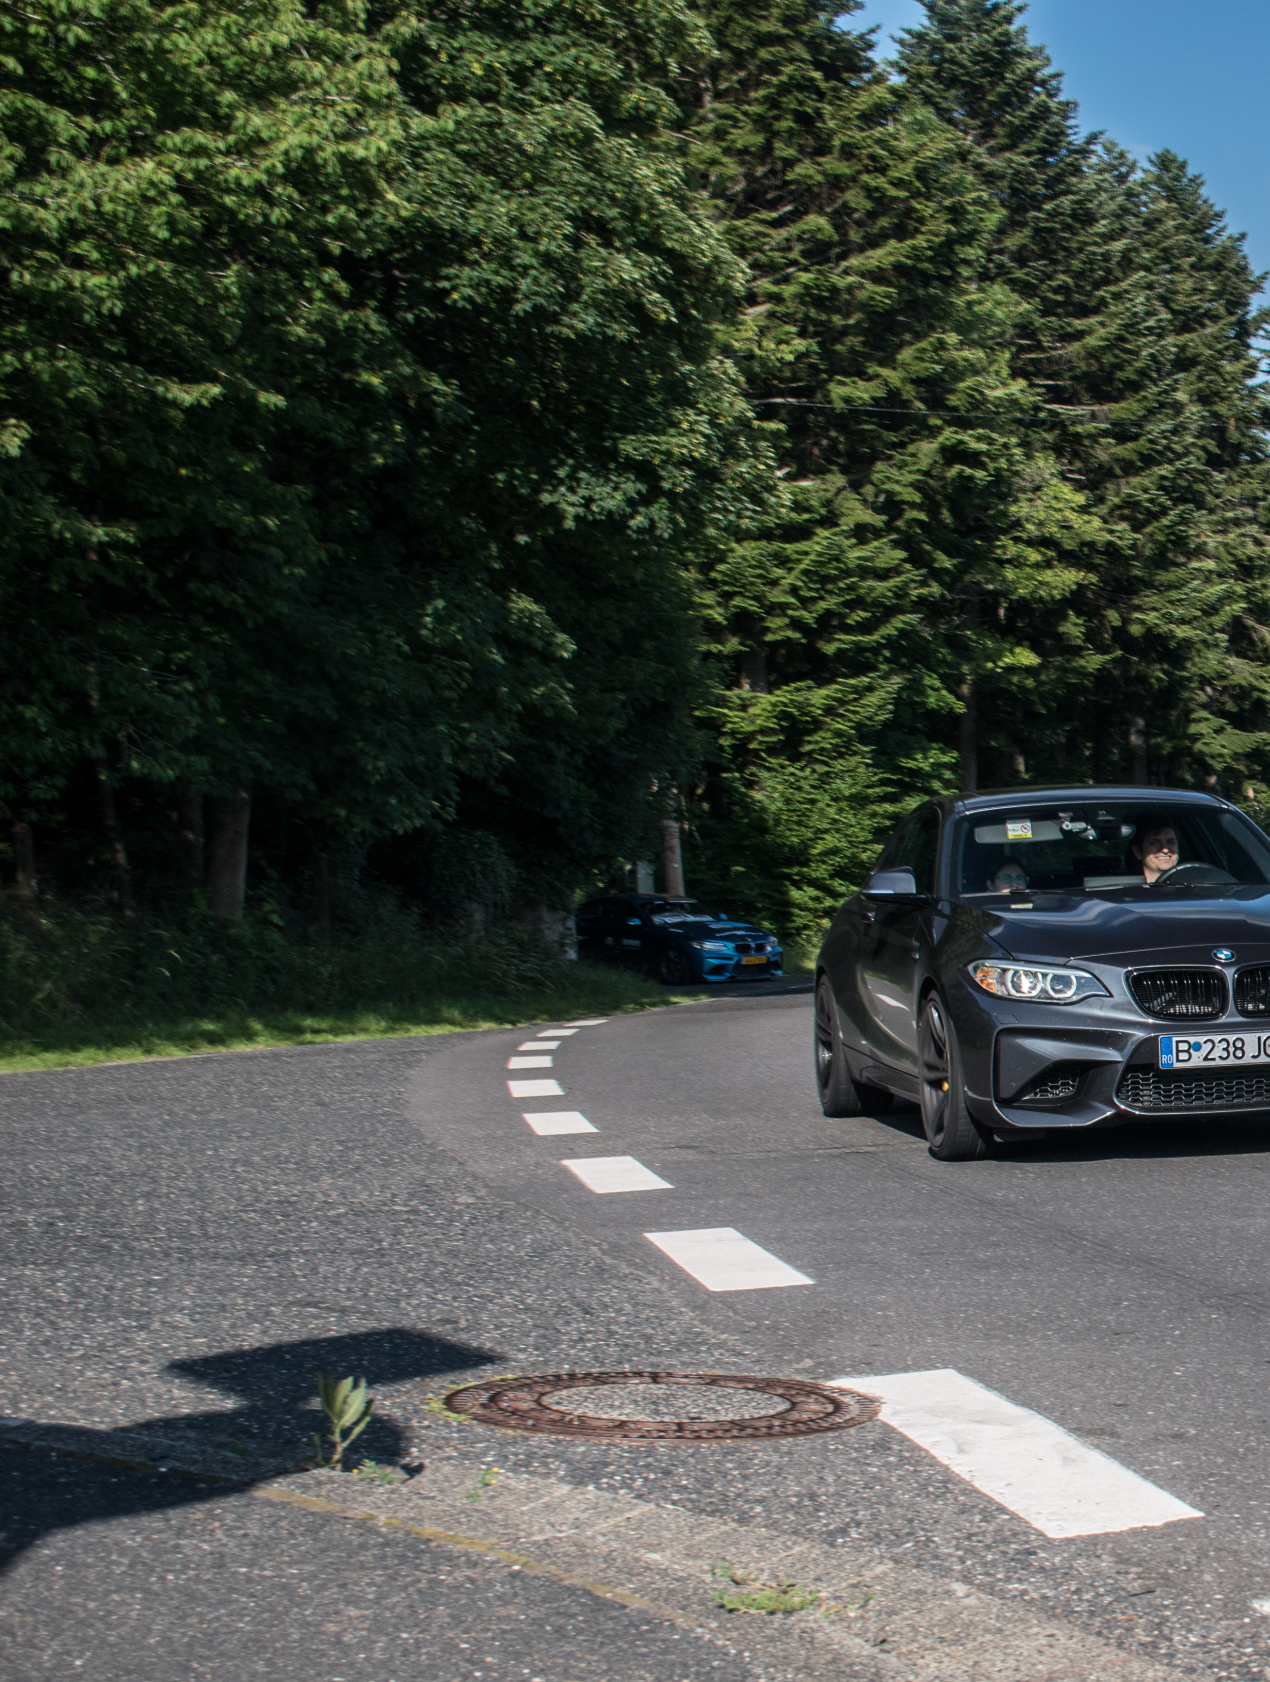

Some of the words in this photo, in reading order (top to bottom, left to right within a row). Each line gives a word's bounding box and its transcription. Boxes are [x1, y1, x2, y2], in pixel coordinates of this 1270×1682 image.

[1175, 1040, 1192, 1062] B
[1203, 1037, 1245, 1061] 238
[1162, 1055, 1173, 1064] RO
